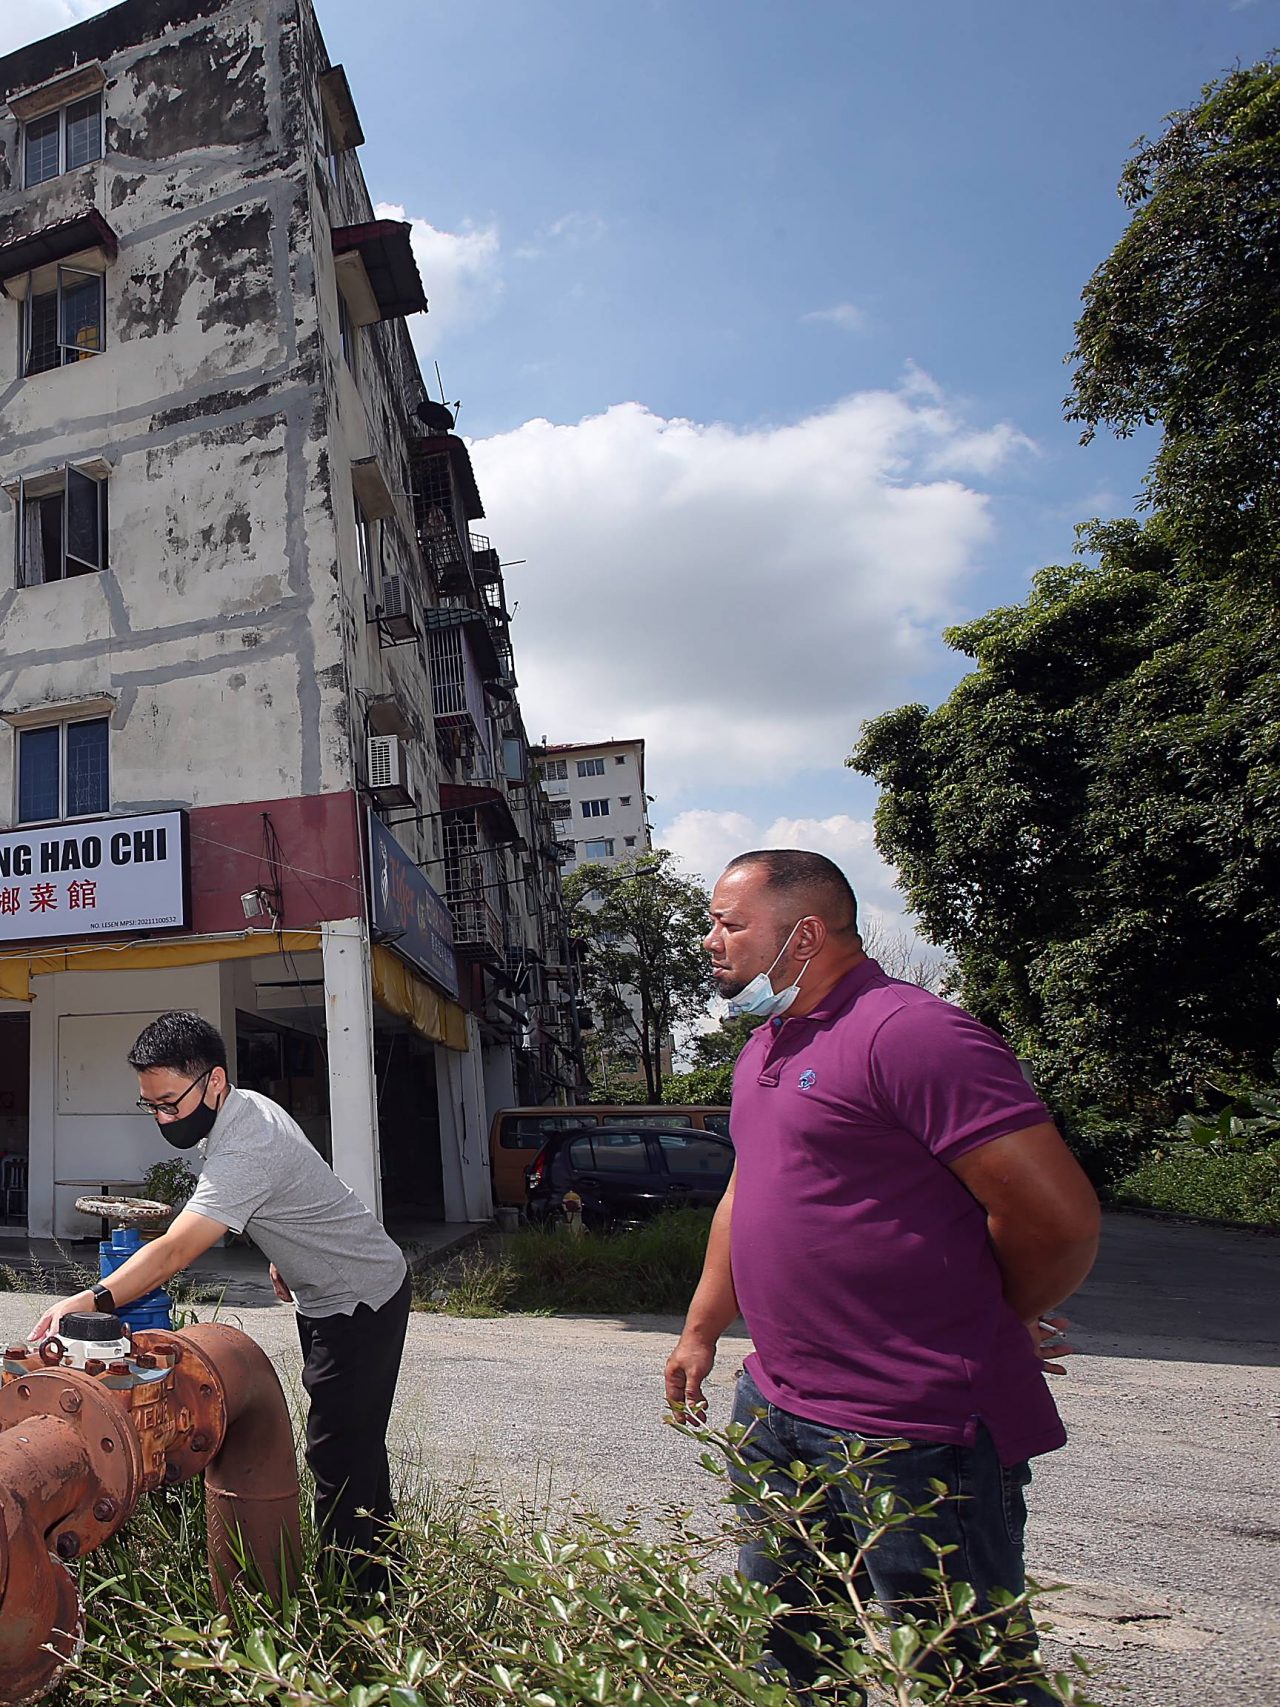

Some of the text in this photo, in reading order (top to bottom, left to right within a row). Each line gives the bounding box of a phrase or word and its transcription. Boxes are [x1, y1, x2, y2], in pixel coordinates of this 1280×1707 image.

[41, 837, 102, 874] HAO
[110, 828, 167, 866] CHI
[120, 919, 136, 927] MPSJ:
